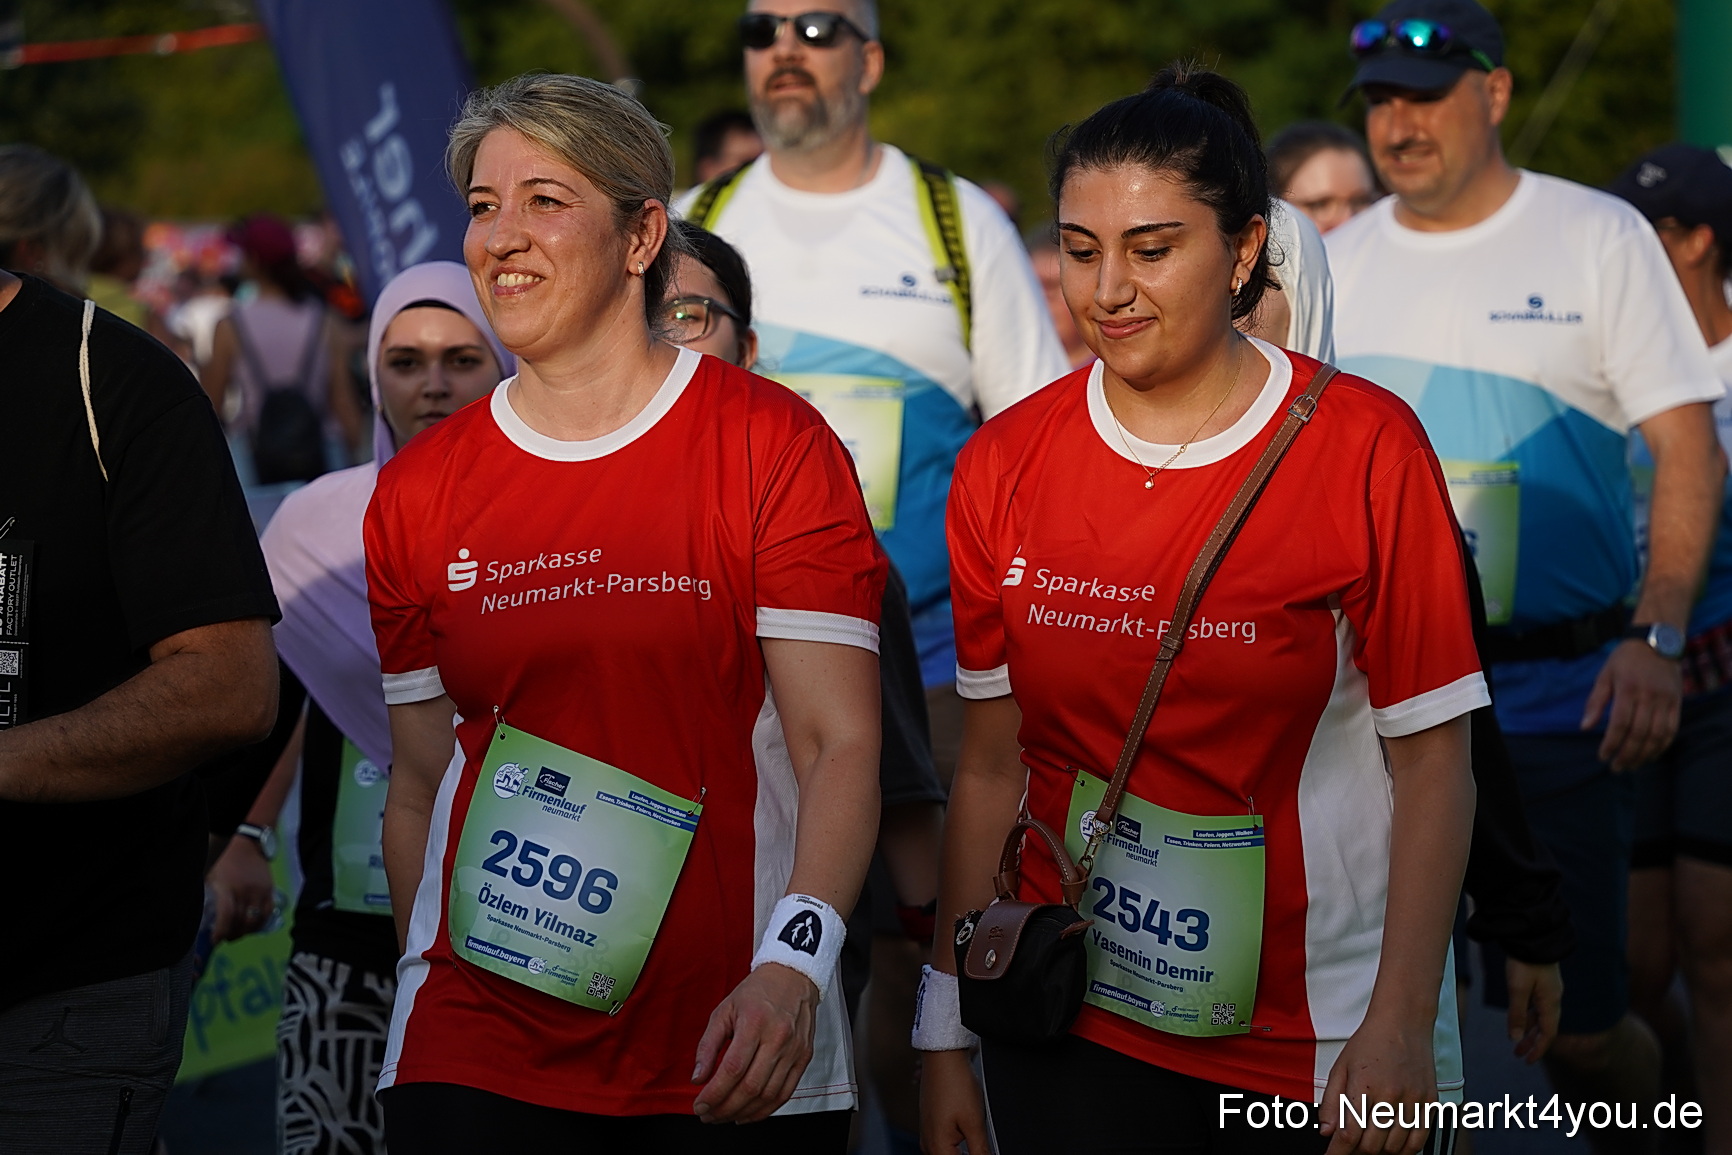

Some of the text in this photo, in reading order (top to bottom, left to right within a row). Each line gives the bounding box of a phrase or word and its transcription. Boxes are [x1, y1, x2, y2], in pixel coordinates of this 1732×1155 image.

[8, 554, 18, 592] OUTLET
[485, 548, 602, 584] Sparkasse
[481, 571, 712, 614] Neumarkt-Parsberg
[1033, 569, 1156, 602] Sparkasse
[6, 593, 15, 636] FACTORY
[1026, 604, 1256, 644] Neumarkt-Psberg
[521, 785, 587, 815] Firmenlauf
[543, 776, 566, 790] Fischer
[541, 804, 581, 822] neumarkt
[599, 793, 682, 827] Essen, Trinken, Feiern, Netzwerken
[631, 793, 687, 818] Laufen, Joggen, Walken
[1106, 832, 1160, 860] Firmenlauf
[1166, 837, 1182, 846] Essen,
[1182, 840, 1204, 848] Trinken,
[1215, 831, 1234, 839] Joggen,
[481, 829, 619, 915] 2596
[1125, 852, 1158, 867] neumarkt
[478, 882, 598, 947] Özlem Yilmaz
[1092, 876, 1210, 952] 2543
[486, 913, 572, 953] Sparkasse Neumarkt-Parsberg
[467, 939, 526, 966] firmenlauf.bayern
[1092, 927, 1215, 983] Yasemin Demir
[1109, 959, 1184, 993] Sparkasse Neumarkt-Parsberg
[190, 953, 287, 1054] pfal
[1092, 983, 1149, 1009] firmenlauf.bayern
